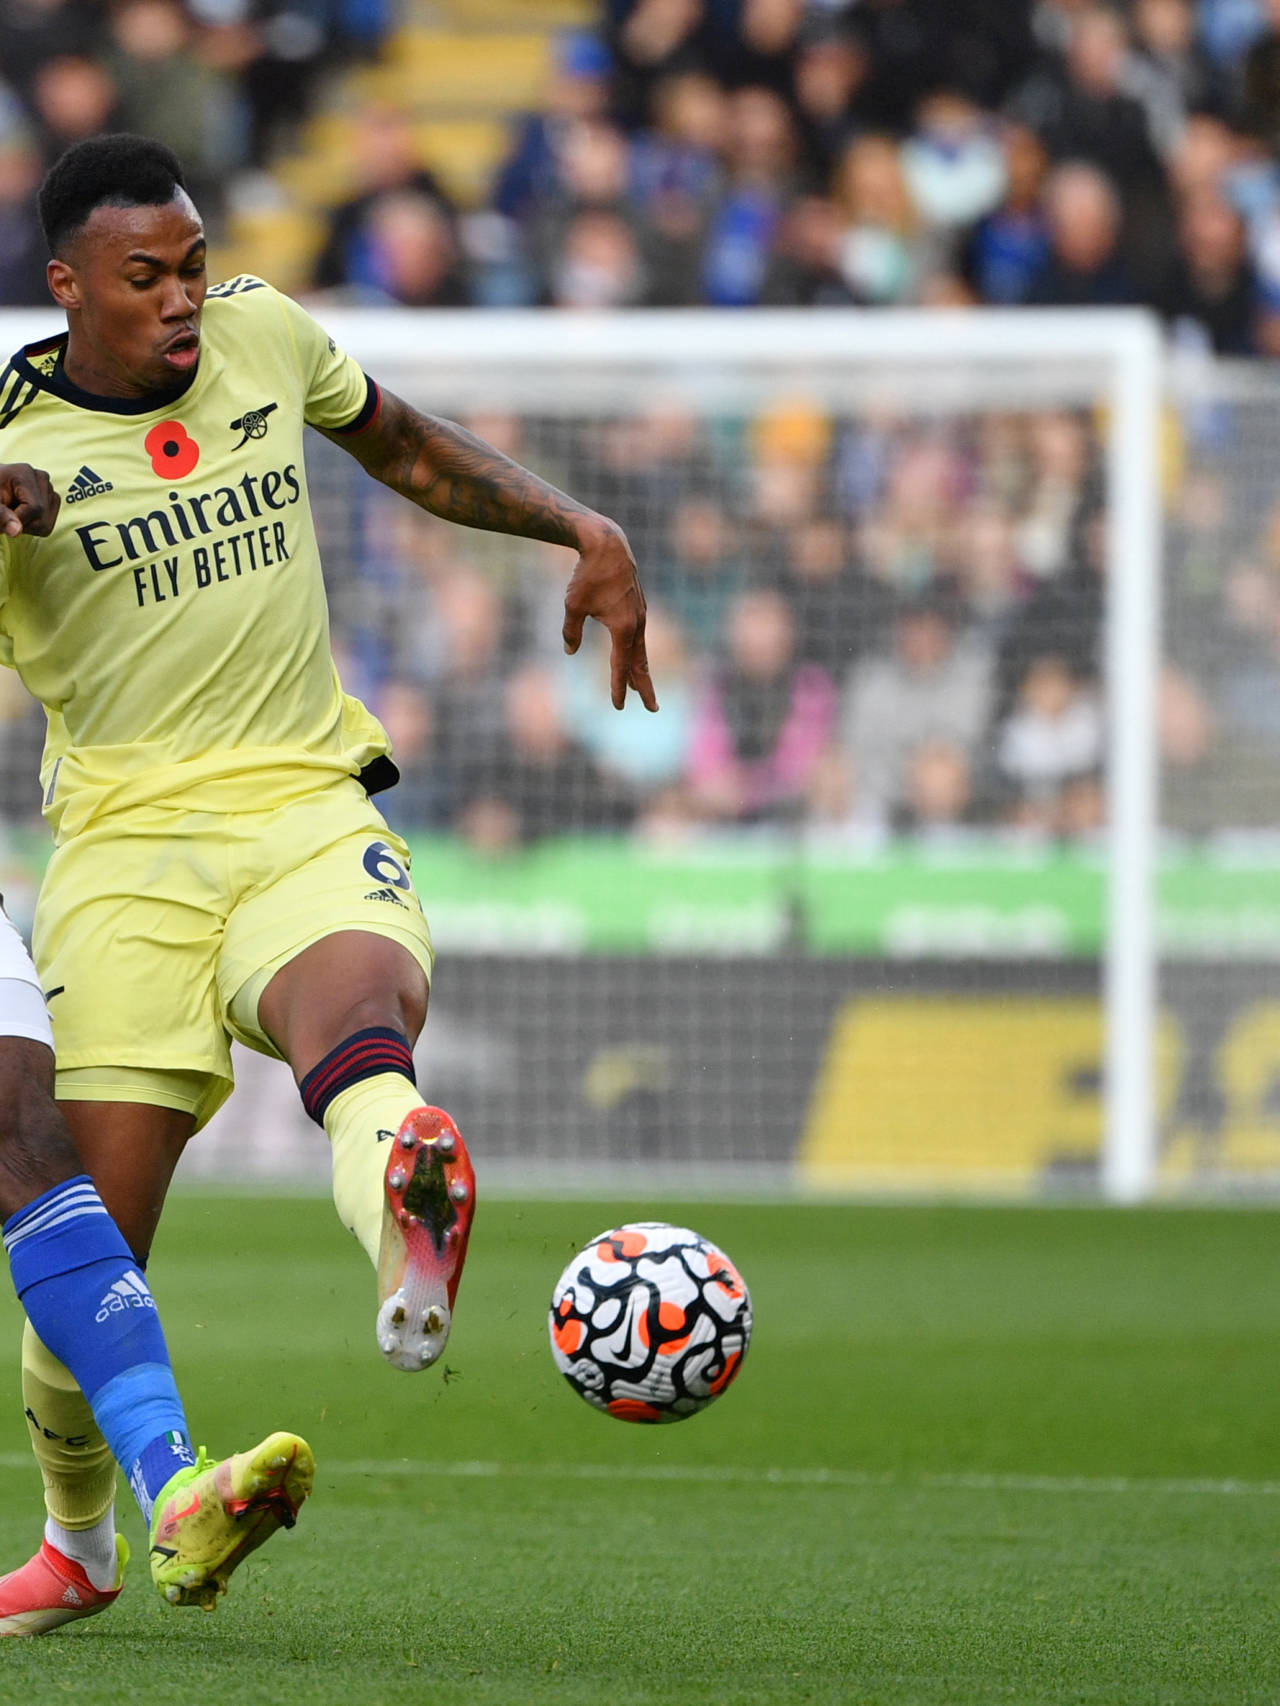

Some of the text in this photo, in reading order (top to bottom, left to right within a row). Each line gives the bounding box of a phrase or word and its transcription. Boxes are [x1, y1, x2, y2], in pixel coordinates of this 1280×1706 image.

[65, 481, 114, 504] adidas
[75, 464, 300, 572] Emirates
[132, 521, 290, 607] FLY BETTER
[361, 840, 412, 893] 6
[95, 1291, 159, 1323] adida
